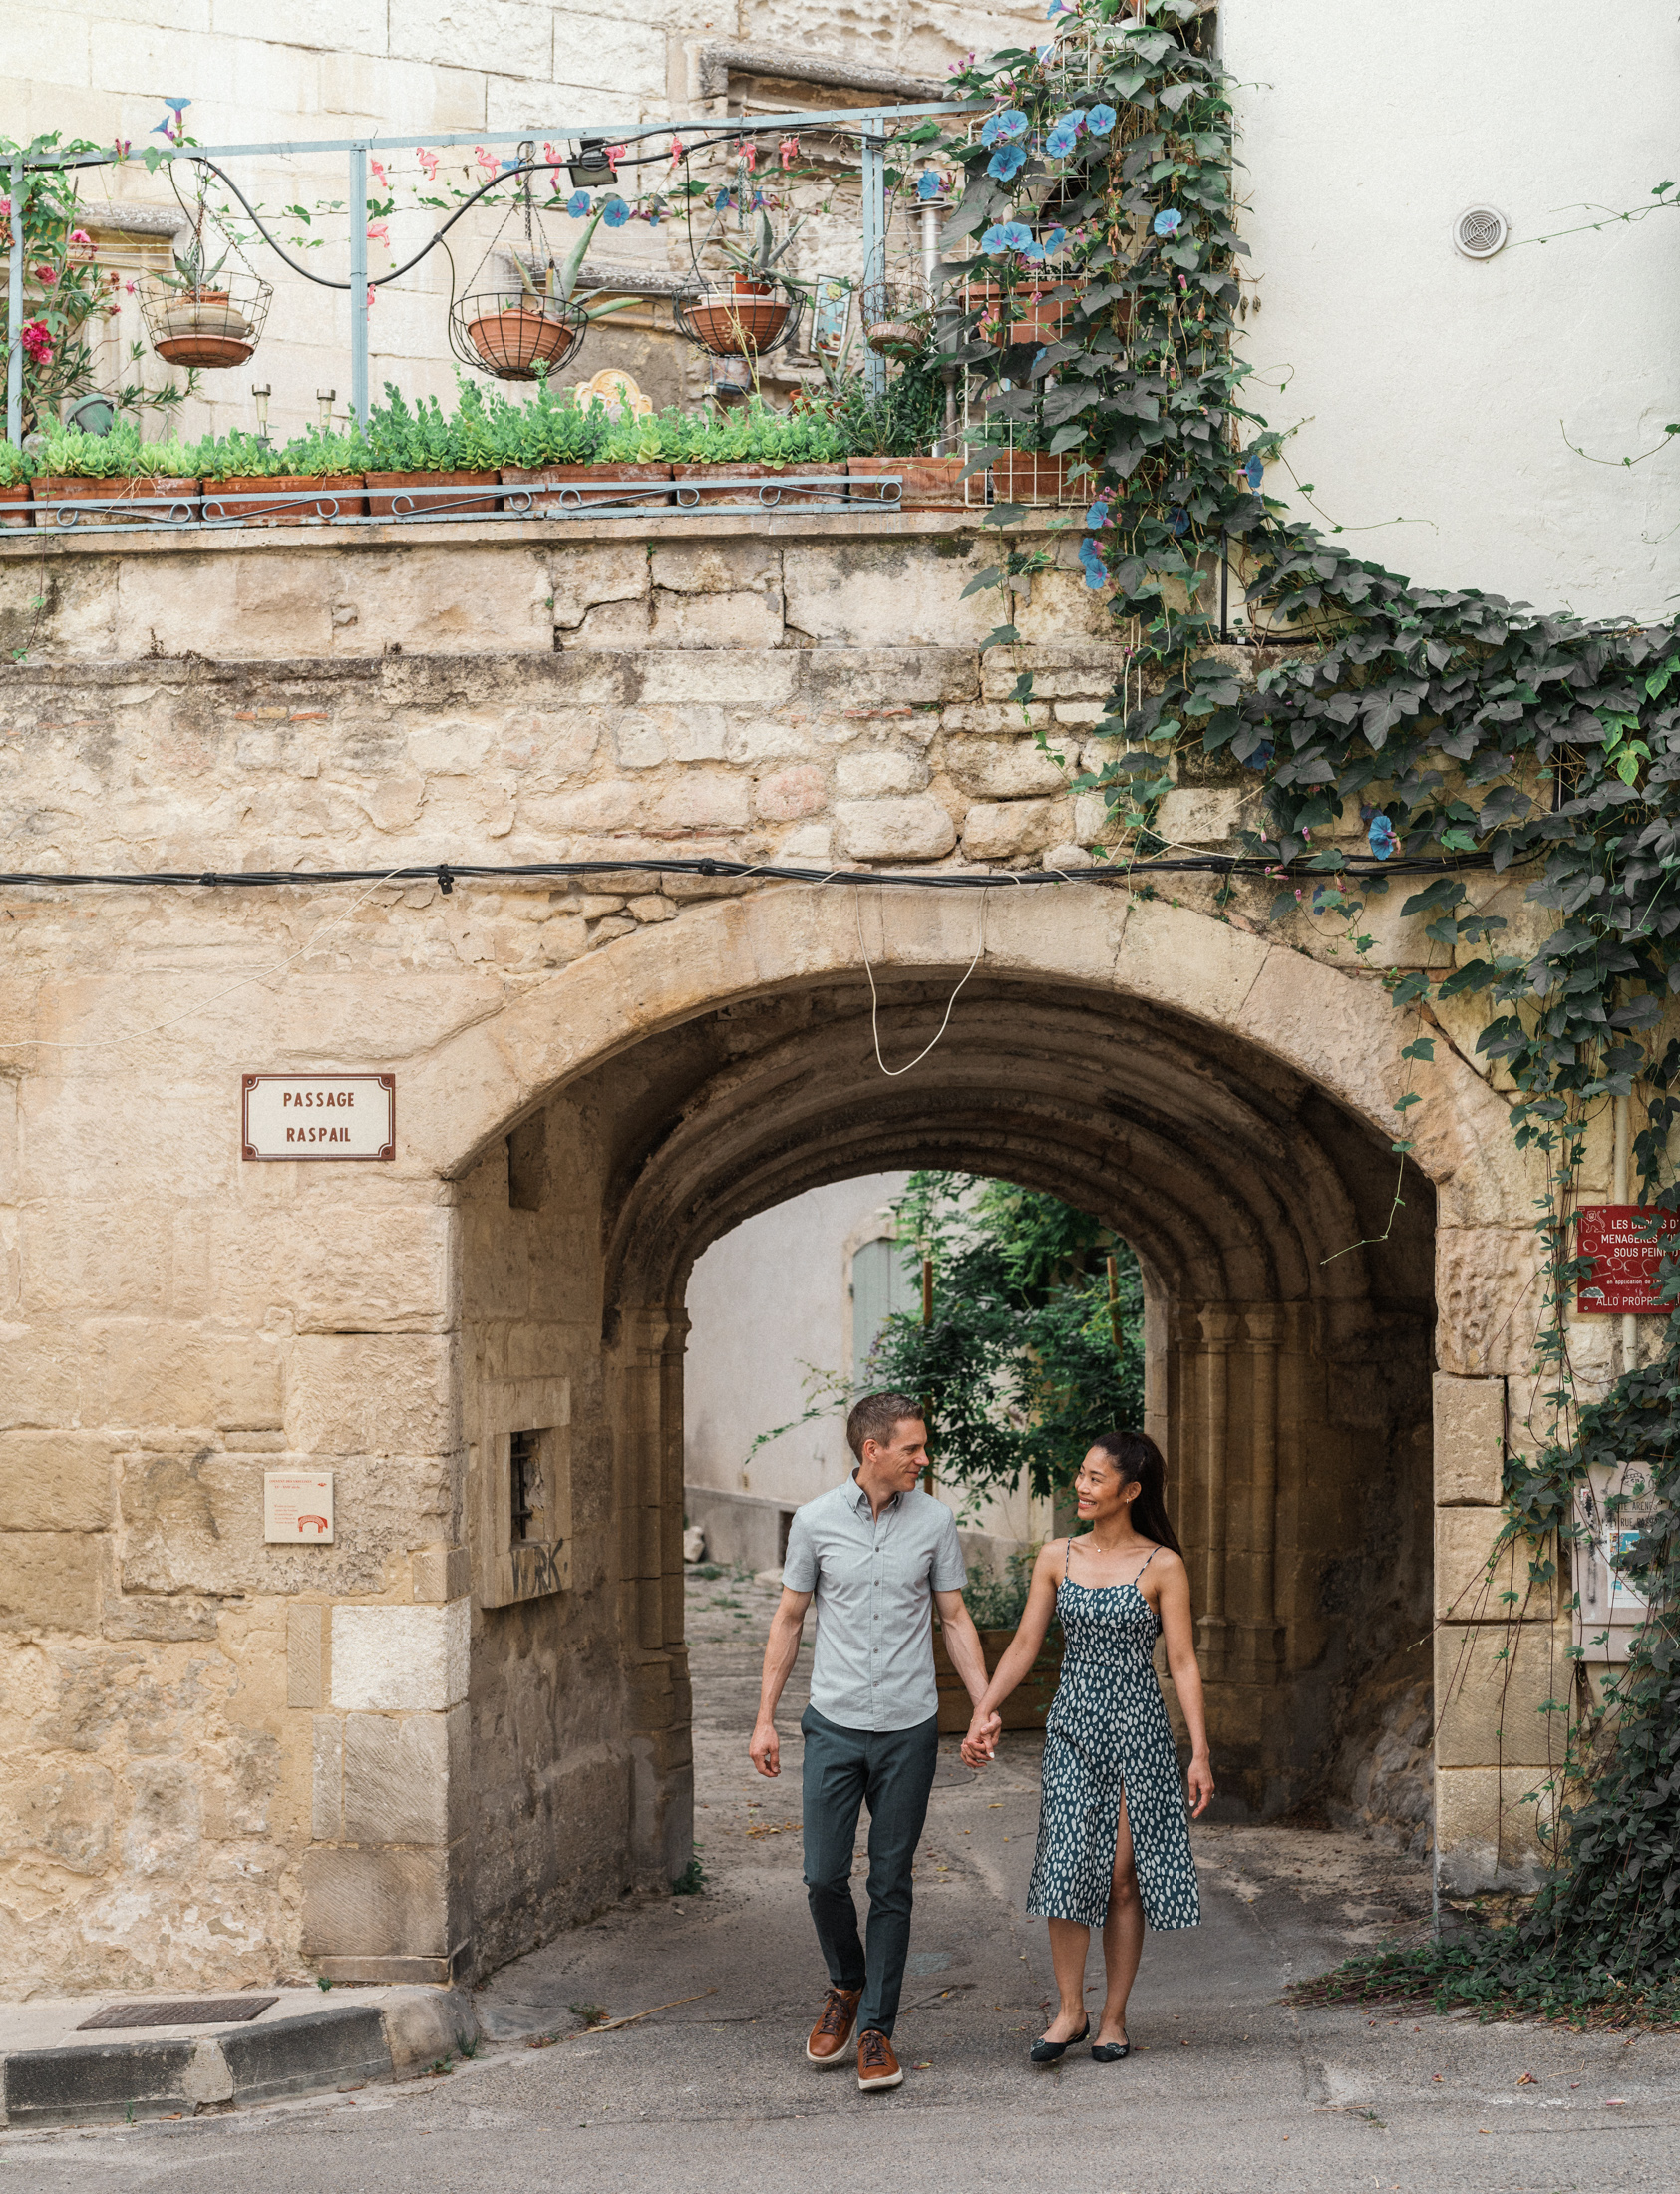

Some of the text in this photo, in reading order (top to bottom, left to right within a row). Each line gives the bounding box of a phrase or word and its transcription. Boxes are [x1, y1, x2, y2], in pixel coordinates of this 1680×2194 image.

[283, 1092, 355, 1107] PASSAGE
[286, 1127, 351, 1142] RASPAIL
[1611, 1219, 1628, 1229] LES
[1613, 1247, 1639, 1258] SOUS
[1596, 1296, 1619, 1306] ALLO
[1620, 1517, 1633, 1527] RUE
